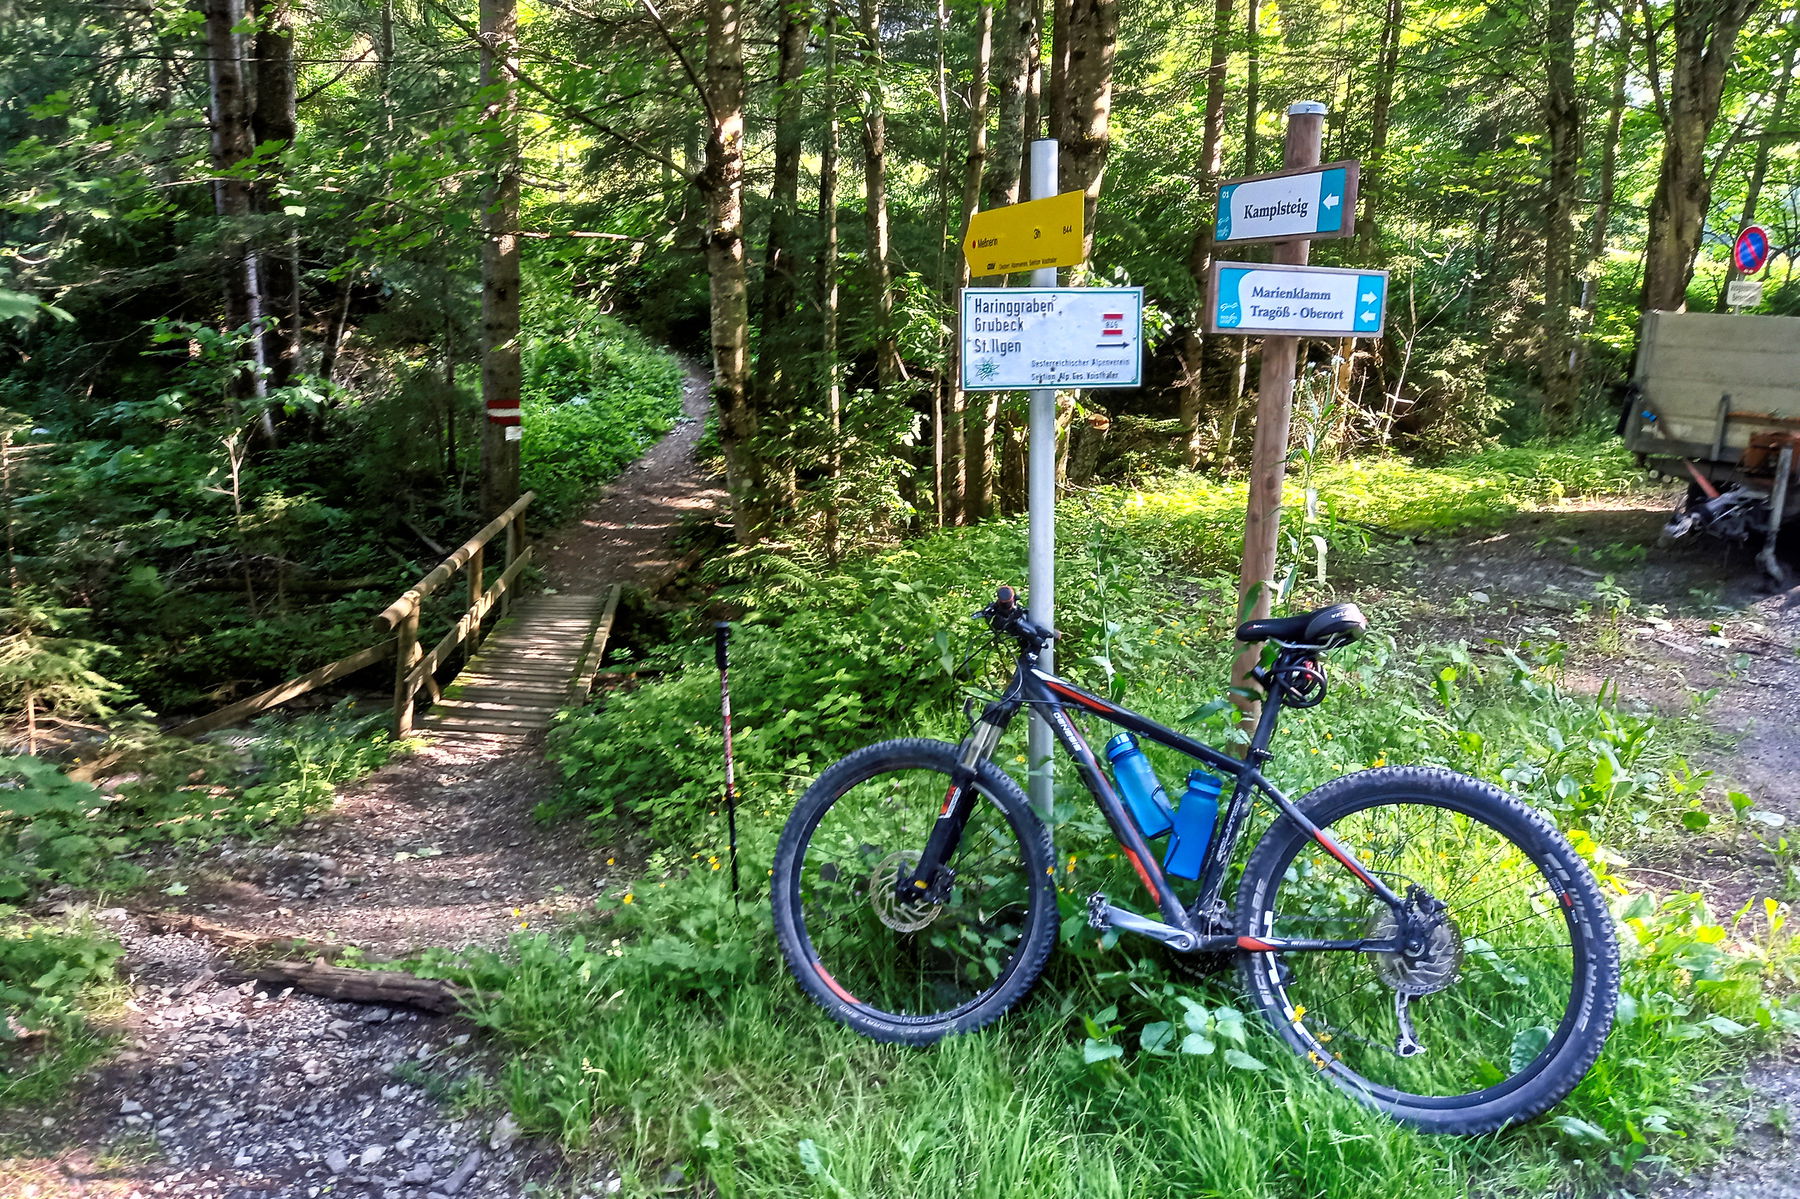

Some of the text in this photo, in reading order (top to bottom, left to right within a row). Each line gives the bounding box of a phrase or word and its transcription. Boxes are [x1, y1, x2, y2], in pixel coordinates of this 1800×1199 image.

[1243, 197, 1309, 221] Kamplsteig
[1062, 225, 1073, 234] 844
[1251, 286, 1331, 300] Marienklamm
[974, 298, 1054, 318] Haringgraben
[1250, 305, 1291, 321] Tragöß
[1300, 306, 1344, 320] Oberort
[974, 317, 1024, 333] Grubeck
[1091, 358, 1130, 367] Alpenverein
[1031, 372, 1056, 381] Sektion
